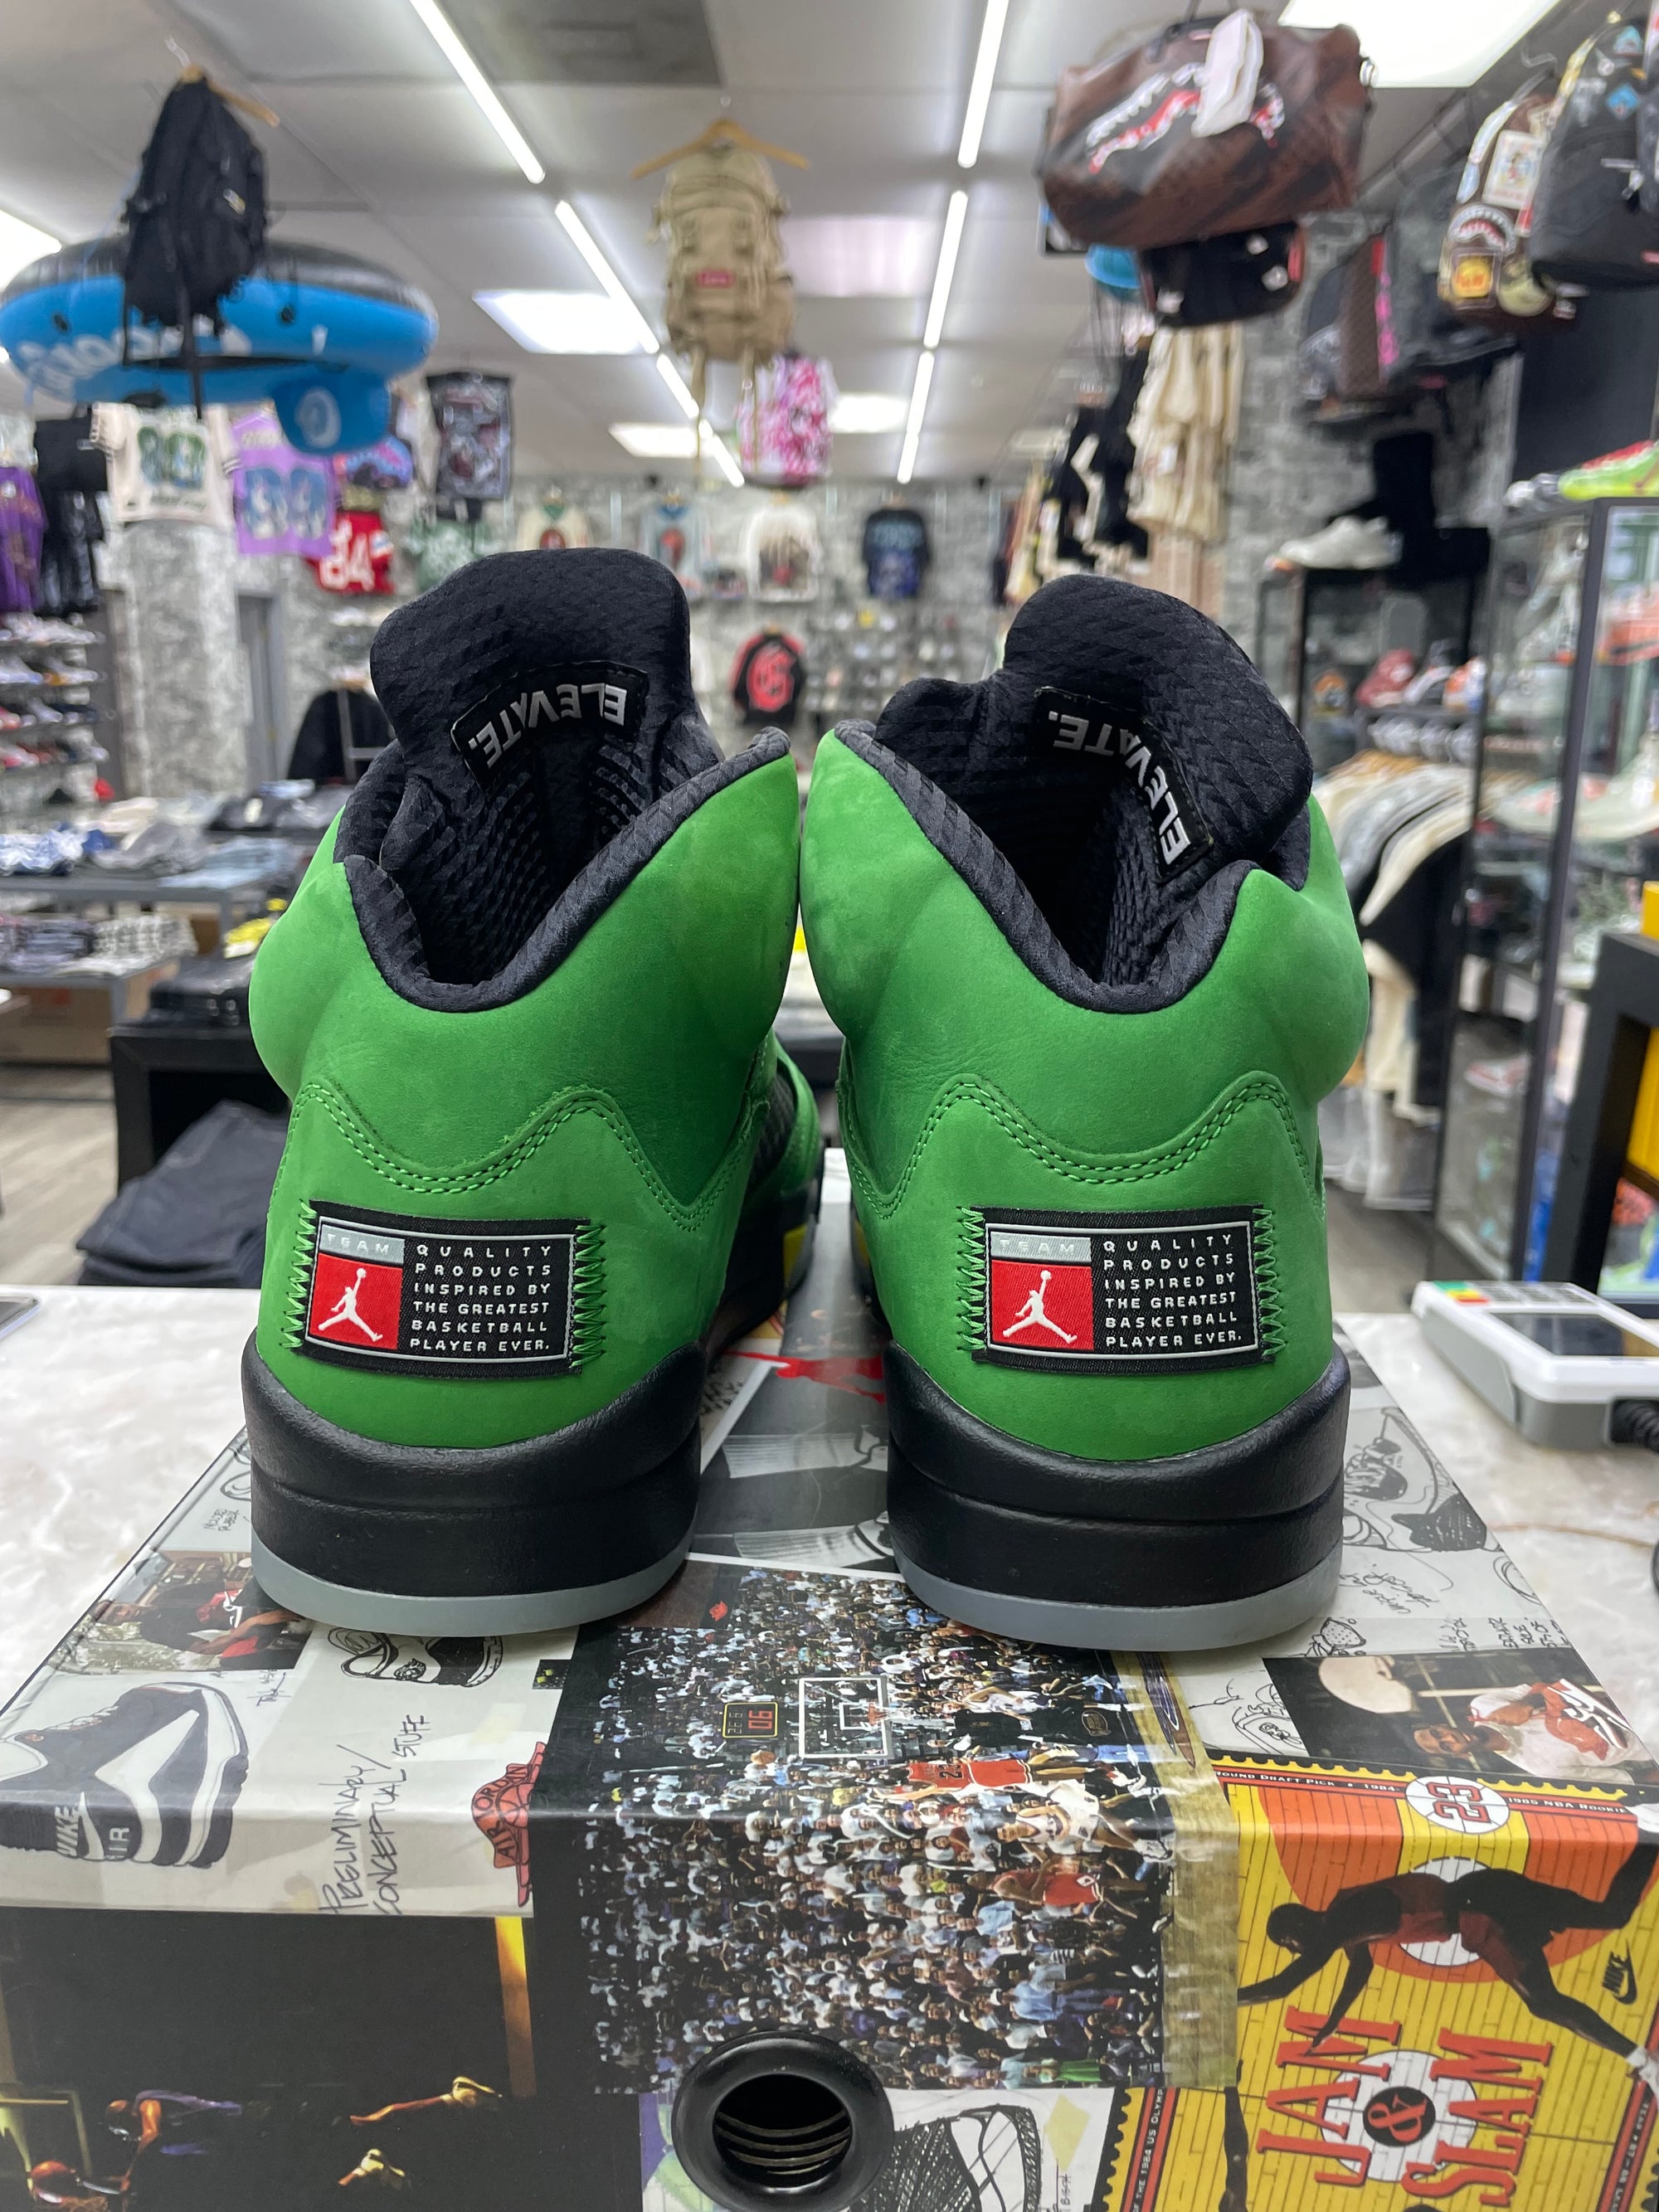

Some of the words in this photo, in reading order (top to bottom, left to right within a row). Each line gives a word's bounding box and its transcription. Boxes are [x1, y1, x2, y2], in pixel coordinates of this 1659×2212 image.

[468, 683, 627, 770] ELEVATE.
[1048, 711, 1191, 865] ELEVATE.
[326, 1232, 390, 1256] TEAM
[416, 1244, 552, 1258] QUALITY
[999, 1238, 1075, 1255] TEAM
[1103, 1233, 1233, 1252] QUALITY
[415, 1263, 552, 1277] PRODUCTS
[1103, 1253, 1234, 1271] PRODUCTS
[414, 1284, 516, 1296] INSPIRED
[528, 1282, 551, 1295] BY
[1104, 1276, 1204, 1291] INSPIRED
[1215, 1272, 1235, 1285] BY
[413, 1300, 449, 1314] THE
[458, 1301, 550, 1315] GREATEST
[1105, 1297, 1141, 1310] THE
[1151, 1291, 1237, 1309] GREATEST
[411, 1320, 547, 1334] BASKETBALL
[1105, 1312, 1238, 1329] BASKETBALL
[410, 1338, 488, 1352] PLAYER
[498, 1339, 550, 1352] EVER.
[1106, 1333, 1183, 1348] PLAYER
[1194, 1330, 1243, 1346] EVER.
[392, 1714, 431, 1758] STUFF
[1508, 1796, 1539, 1806] 1985
[1544, 1800, 1574, 1810] NBA
[487, 1820, 516, 1859] AIR
[1256, 2005, 1402, 2187] JAM
[1367, 2094, 1428, 2143] &
[1400, 2026, 1554, 2208] SLAM
[1146, 2128, 1156, 2145] US
[1141, 2148, 1152, 2176] 1984
[1135, 2179, 1146, 2200] THE
